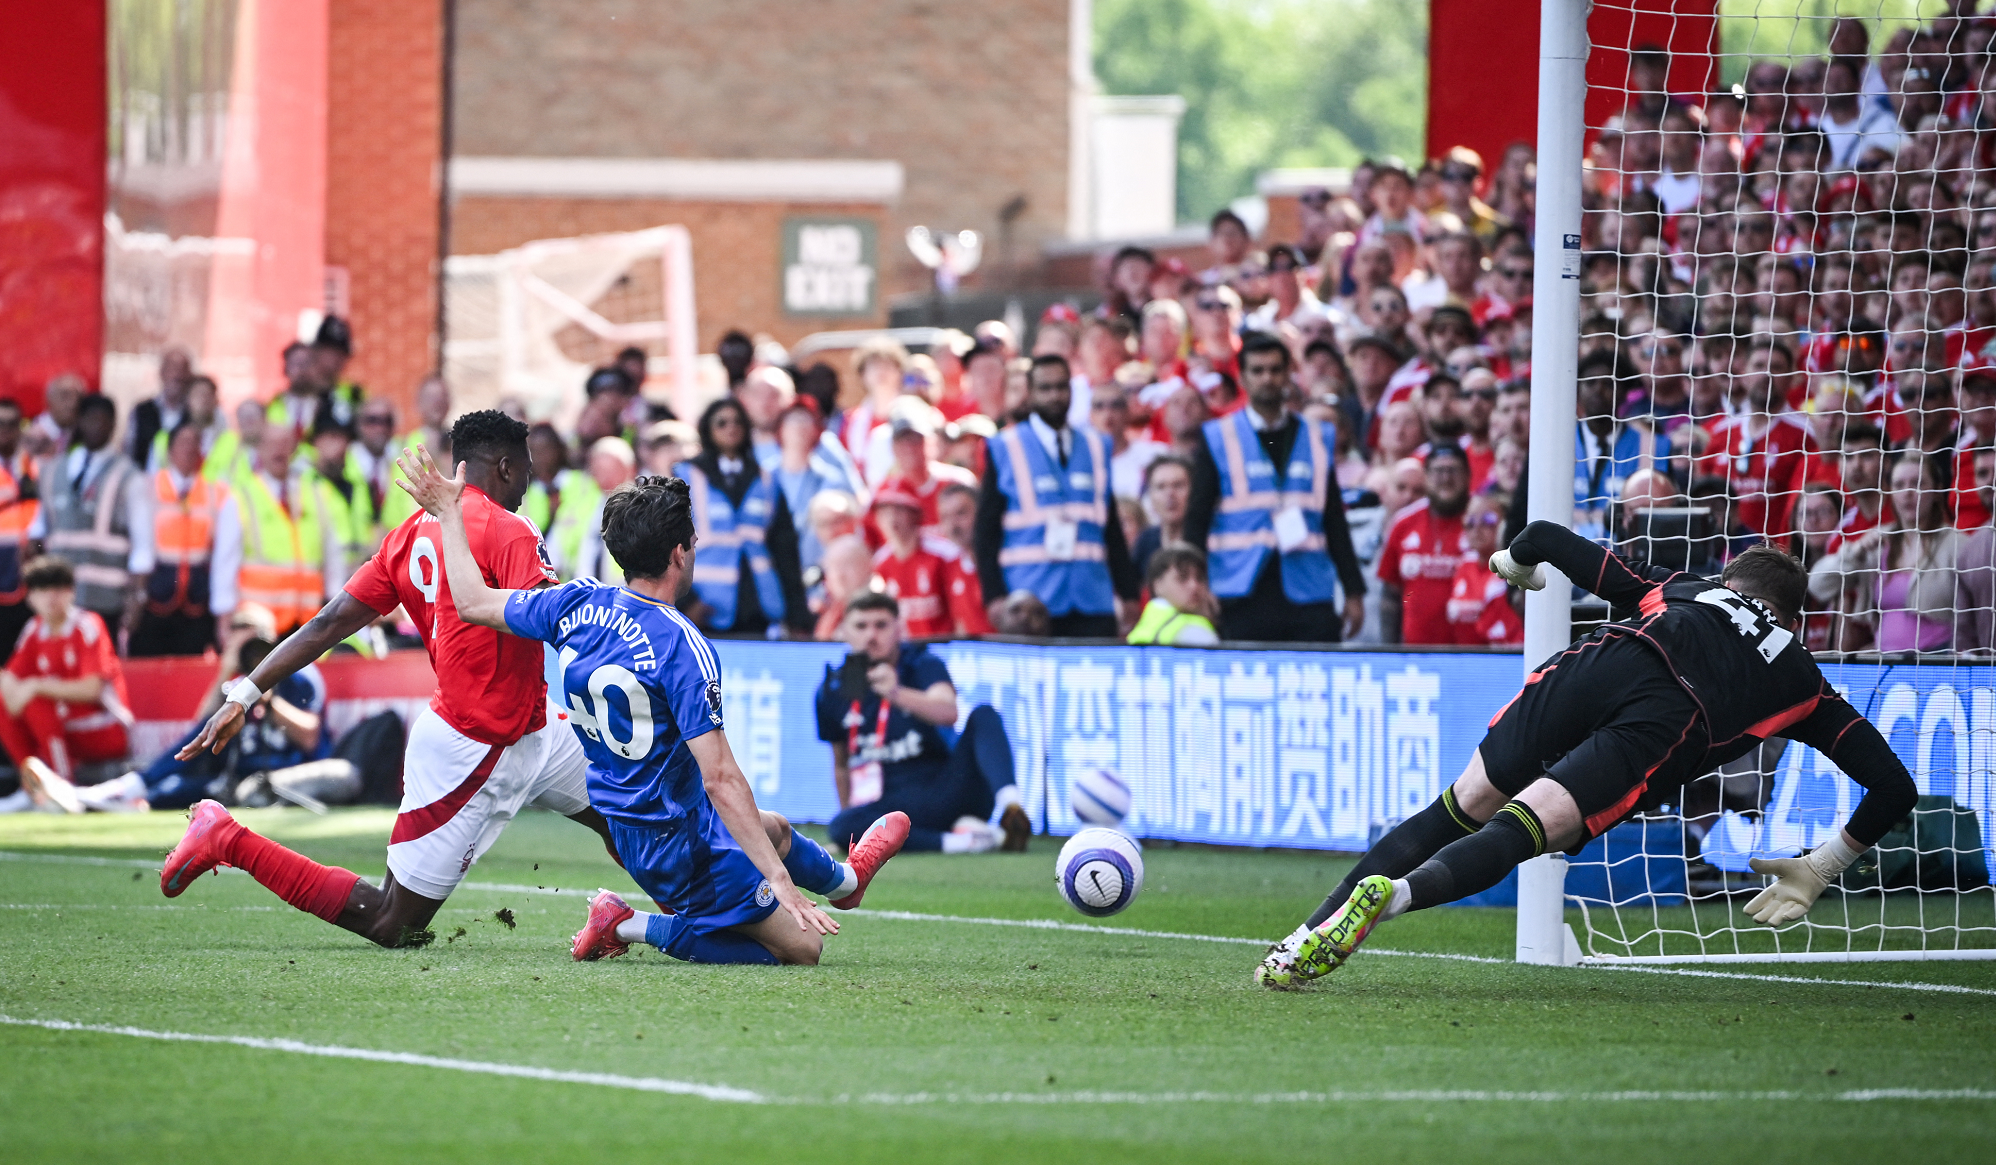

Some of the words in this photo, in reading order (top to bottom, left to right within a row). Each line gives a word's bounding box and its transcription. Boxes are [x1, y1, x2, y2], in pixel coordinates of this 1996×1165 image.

[798, 224, 862, 262] NO
[785, 264, 873, 310] EXIT
[409, 536, 439, 639] 9
[558, 603, 657, 672] BUONINOTTE
[1694, 588, 1794, 665] 41
[558, 645, 654, 761] 40
[1301, 883, 1385, 976] PREDATOR
